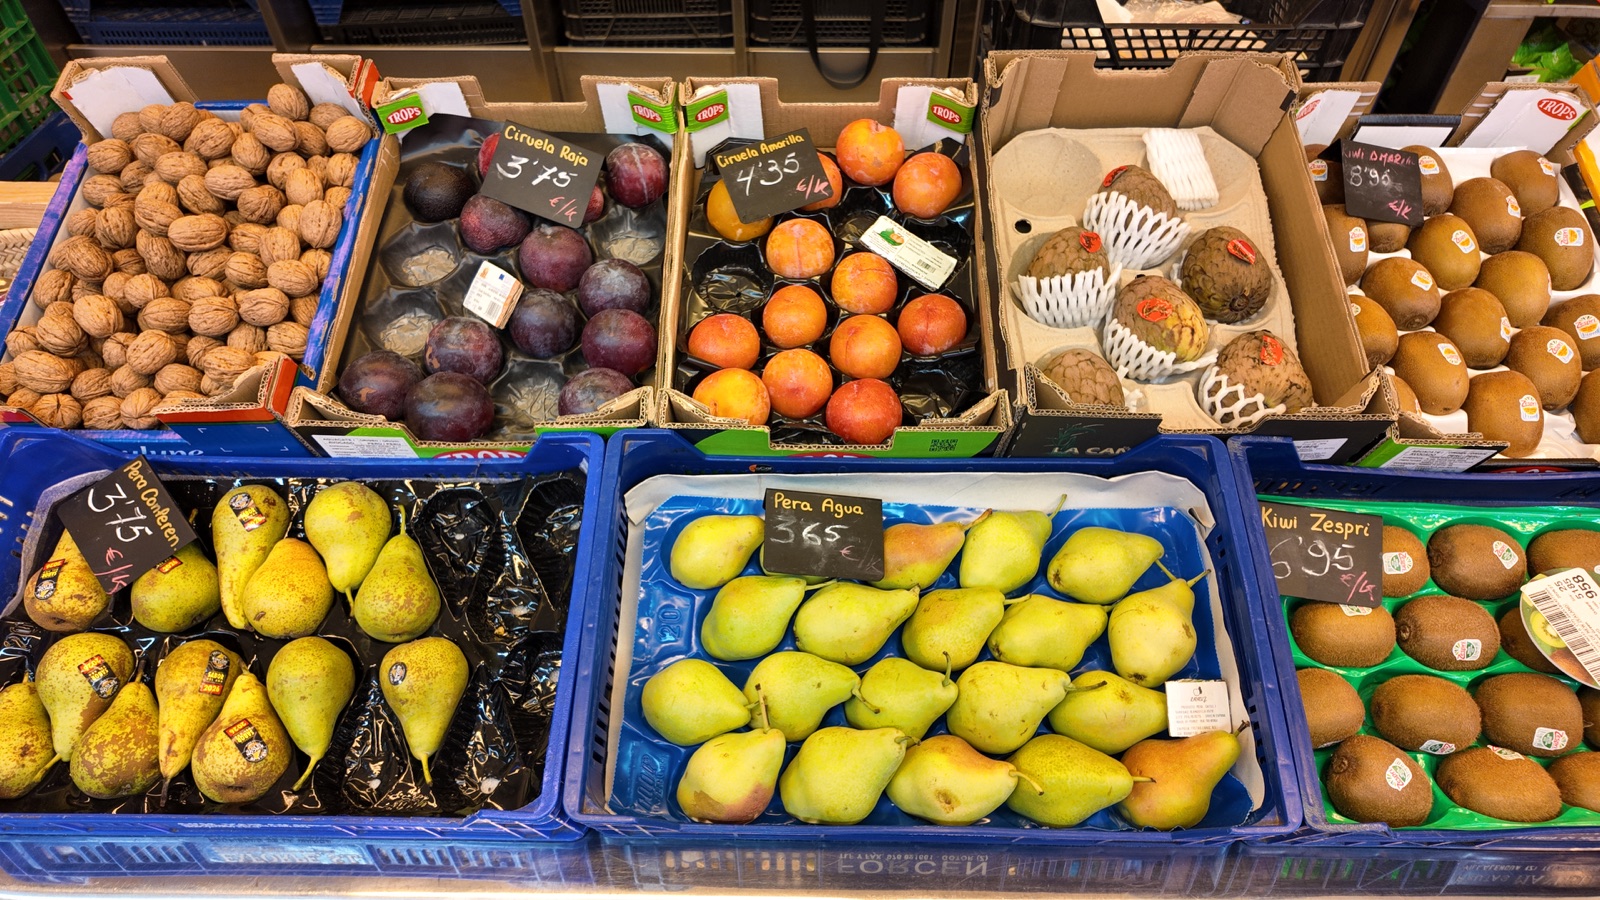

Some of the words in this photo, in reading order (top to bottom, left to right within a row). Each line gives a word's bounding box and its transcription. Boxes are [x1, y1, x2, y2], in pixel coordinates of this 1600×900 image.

[387, 107, 421, 123] TROPS
[632, 104, 662, 122] TROPS
[697, 103, 725, 121] TROPS
[932, 105, 961, 122] TROPS
[1539, 98, 1576, 120] TROPS
[504, 125, 555, 155] Ciruela
[716, 148, 759, 168] Ciruela
[760, 134, 804, 155] Amarilla
[1052, 447, 1079, 455] LA
[123, 460, 147, 490] Pera
[774, 492, 812, 511] Pera
[822, 498, 863, 518] Agua
[1261, 506, 1297, 529] Kiwi
[1310, 513, 1370, 540] Zespri
[1554, 580, 1567, 593] 25
[1563, 577, 1585, 600] 5185
[1571, 574, 1598, 600] 958
